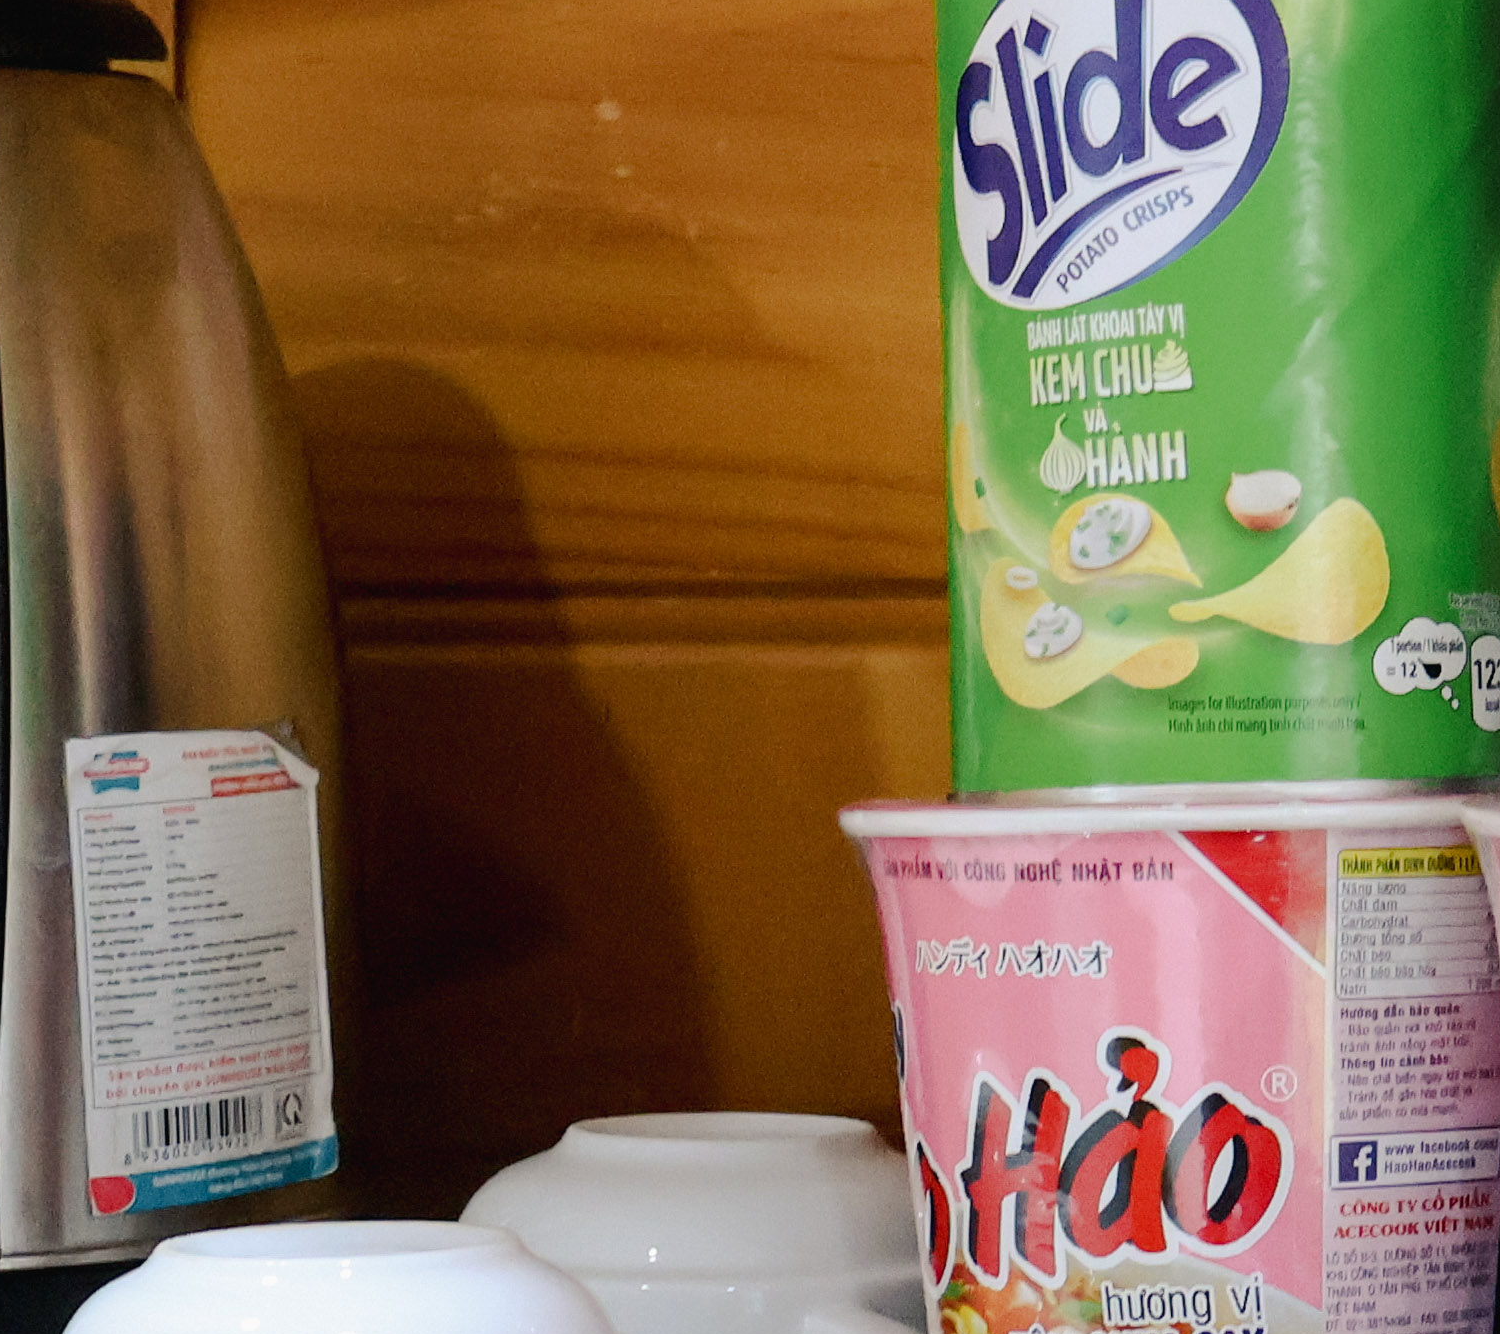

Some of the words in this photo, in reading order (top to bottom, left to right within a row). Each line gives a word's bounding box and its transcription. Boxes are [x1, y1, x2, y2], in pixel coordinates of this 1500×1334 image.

[1055, 226, 1120, 294] POTATO
[1122, 184, 1196, 234] CRISPS
[1090, 308, 1135, 342] KHOAI
[1029, 350, 1087, 407] KEM
[1014, 857, 1063, 886] NGHỆ
[1072, 856, 1124, 887] NHẬT
[1133, 855, 1175, 883] BẢN
[996, 940, 1113, 976] ハオハオ
[960, 1036, 1283, 1279] Hảo
[1340, 1197, 1390, 1217] CÔNG
[1398, 1199, 1418, 1214] TY
[1422, 1187, 1446, 1212] CỔ
[1334, 1221, 1420, 1240] ACECOOK
[1424, 1215, 1461, 1235] VIỆT
[1103, 1285, 1212, 1326] hương
[1230, 1276, 1262, 1321] vị
